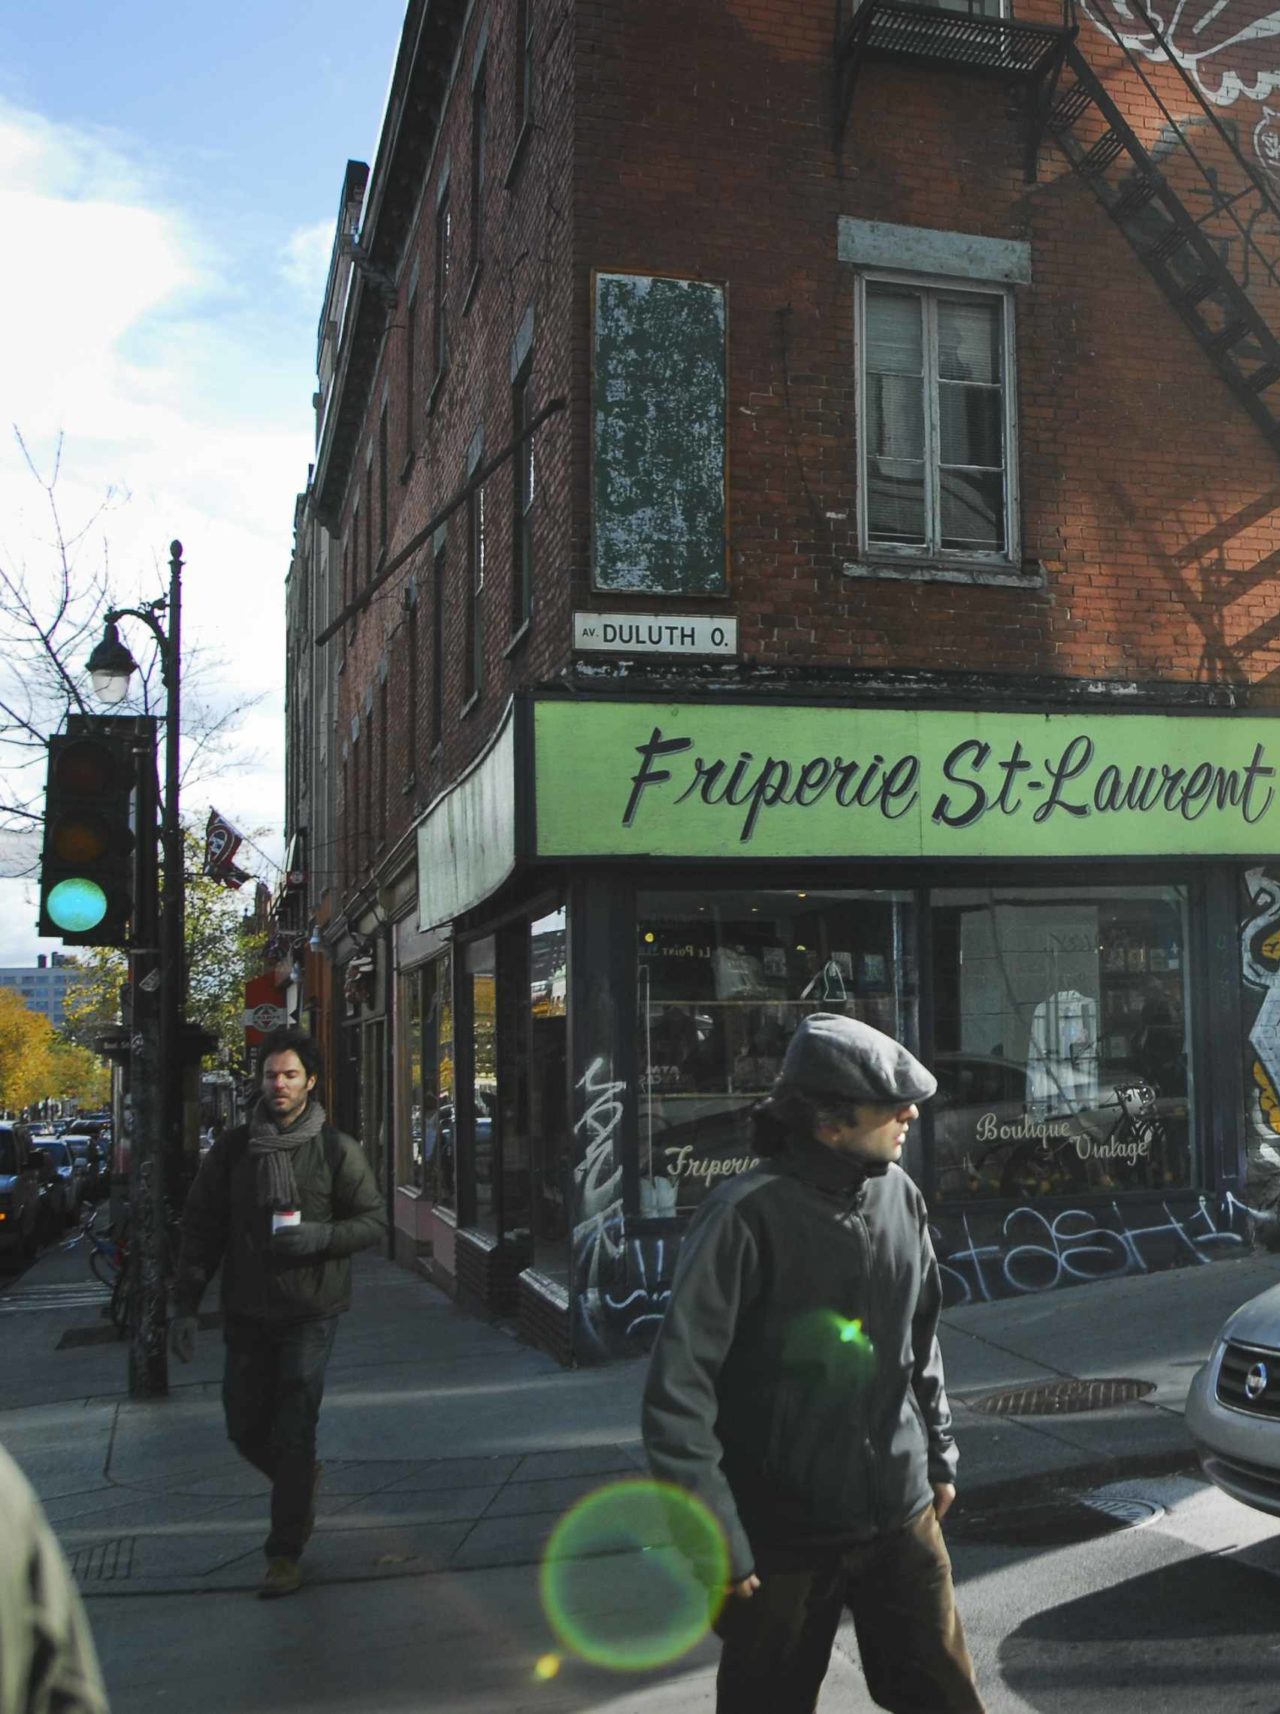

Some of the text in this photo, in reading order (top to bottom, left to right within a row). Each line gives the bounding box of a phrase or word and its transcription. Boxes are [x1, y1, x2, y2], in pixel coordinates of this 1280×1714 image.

[582, 623, 729, 647] AV. DULUTH O.
[622, 727, 1274, 843] Friperie St-Laurent
[976, 1112, 1071, 1149] Boutique
[1069, 1133, 1149, 1167] Vintage
